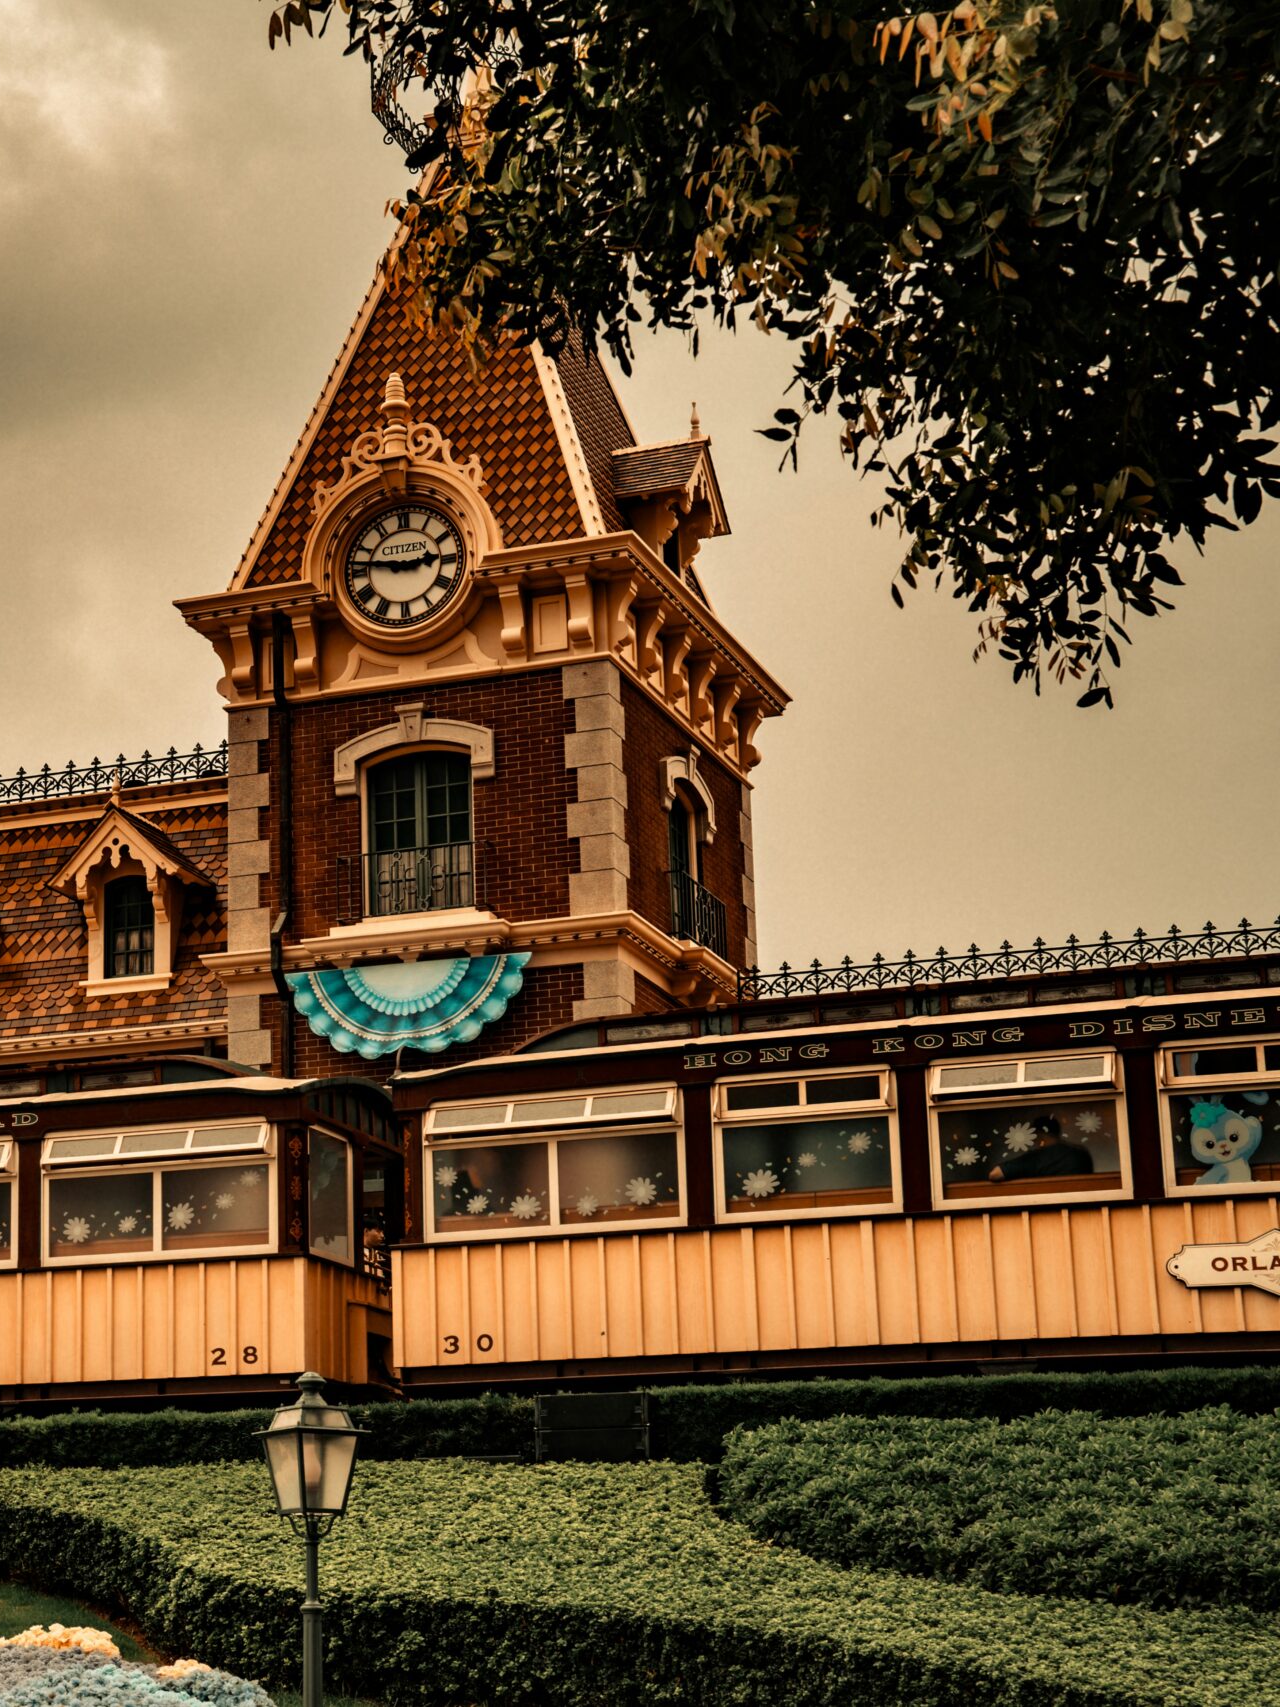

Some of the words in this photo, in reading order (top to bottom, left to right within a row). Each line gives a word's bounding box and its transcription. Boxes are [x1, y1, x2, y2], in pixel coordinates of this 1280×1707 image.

[382, 540, 427, 556] CITIZEN
[683, 1044, 829, 1069] HONG
[872, 1027, 1024, 1053] KONG
[1069, 1008, 1280, 1037] DISNE
[443, 1333, 494, 1354] 30
[210, 1345, 259, 1366] 28
